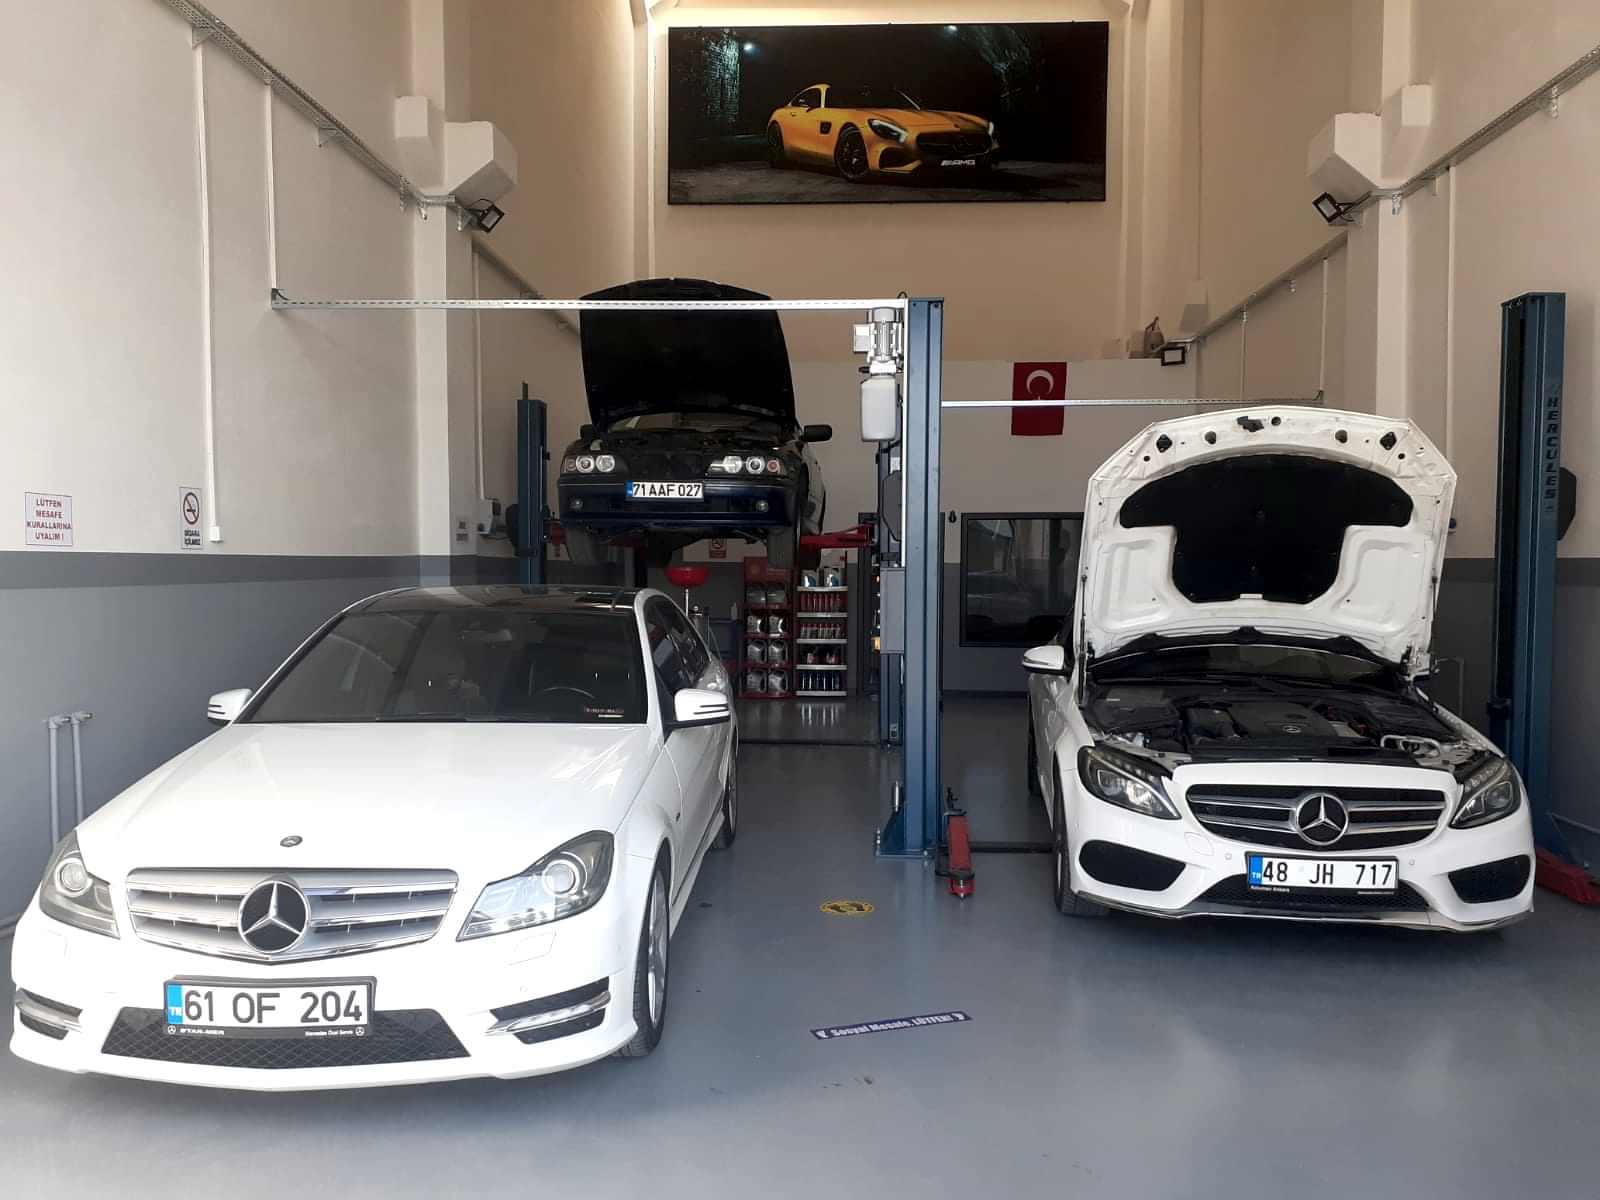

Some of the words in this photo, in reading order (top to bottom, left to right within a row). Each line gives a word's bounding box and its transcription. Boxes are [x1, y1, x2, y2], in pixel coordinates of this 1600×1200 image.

[1544, 397, 1559, 499] HERCULES
[633, 484, 646, 496] 71
[648, 484, 675, 496] AAF
[678, 484, 701, 497] 027
[1263, 861, 1288, 882] 48
[1309, 863, 1334, 885] JH
[1355, 864, 1392, 885] 717
[185, 990, 214, 1022] 61
[232, 992, 280, 1023] OF
[300, 990, 362, 1023] 204
